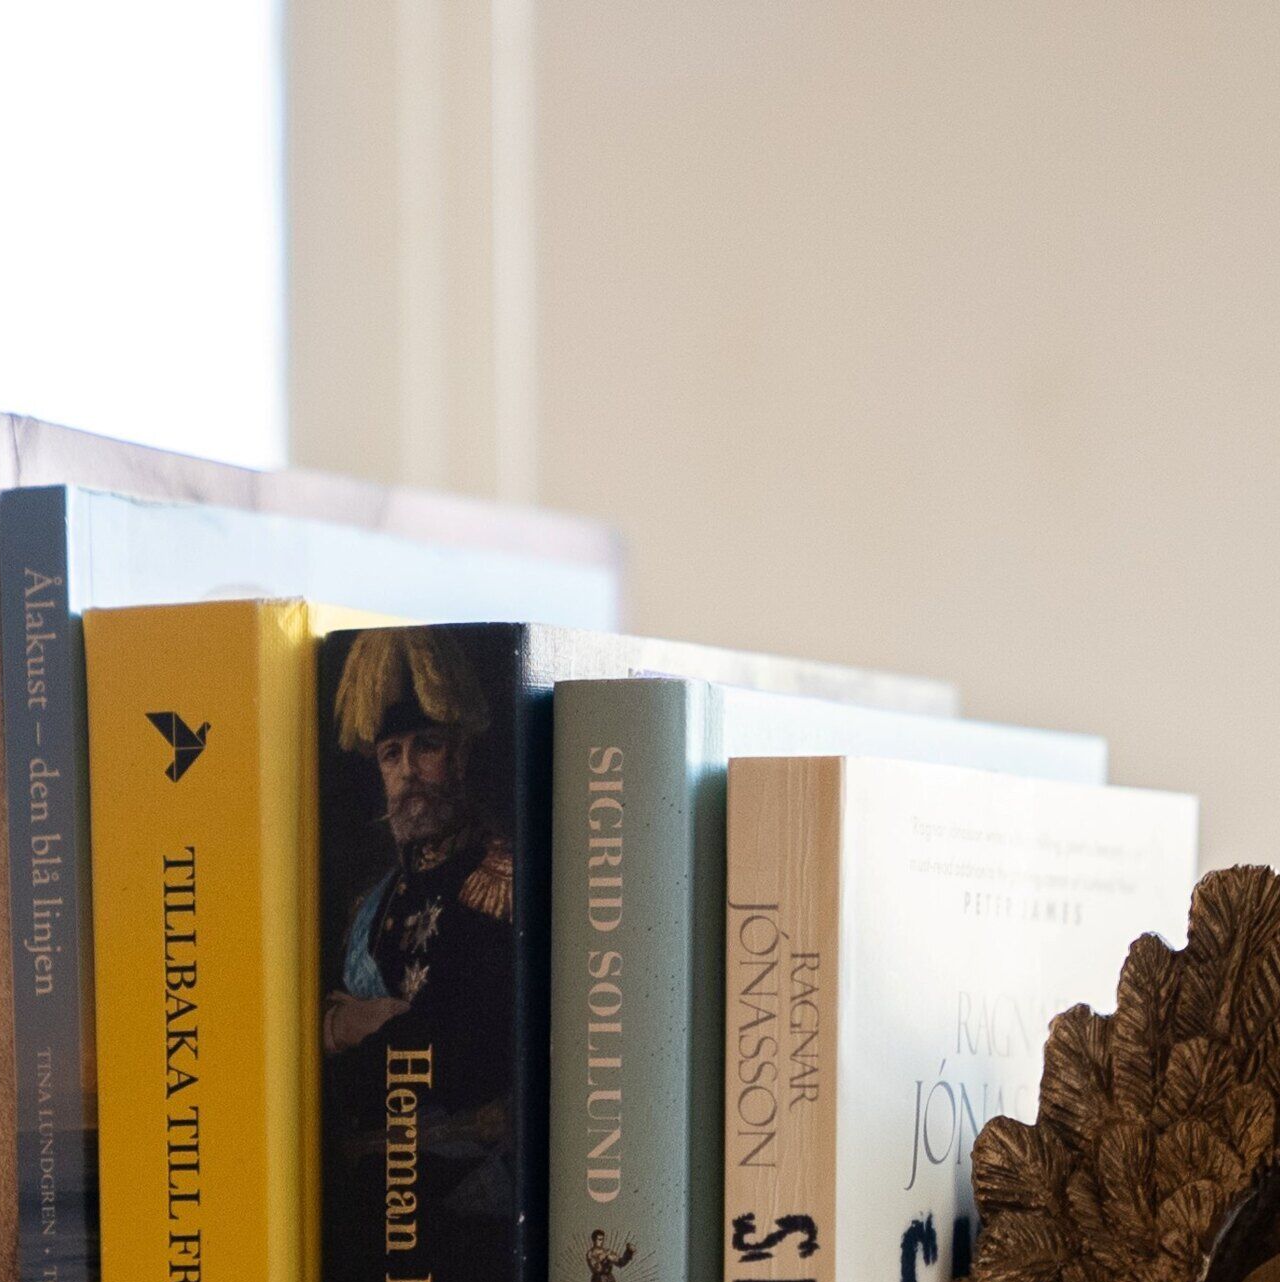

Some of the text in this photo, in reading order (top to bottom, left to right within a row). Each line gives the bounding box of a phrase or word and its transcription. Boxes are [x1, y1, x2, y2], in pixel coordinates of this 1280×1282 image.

[24, 566, 63, 709] Ålakust
[29, 756, 61, 825] den
[30, 832, 63, 888] blå
[24, 895, 64, 998] linjen
[162, 845, 199, 1101] TILLBAKA
[585, 745, 625, 1205] SIGRID SOLLUND
[36, 1046, 53, 1103] TINA
[727, 900, 790, 1169] JÓNASSON
[789, 951, 821, 1113] RAGNAR
[37, 1108, 59, 1237] LUNDGREN
[166, 1105, 202, 1221] TILL
[384, 1043, 434, 1256] Herman
